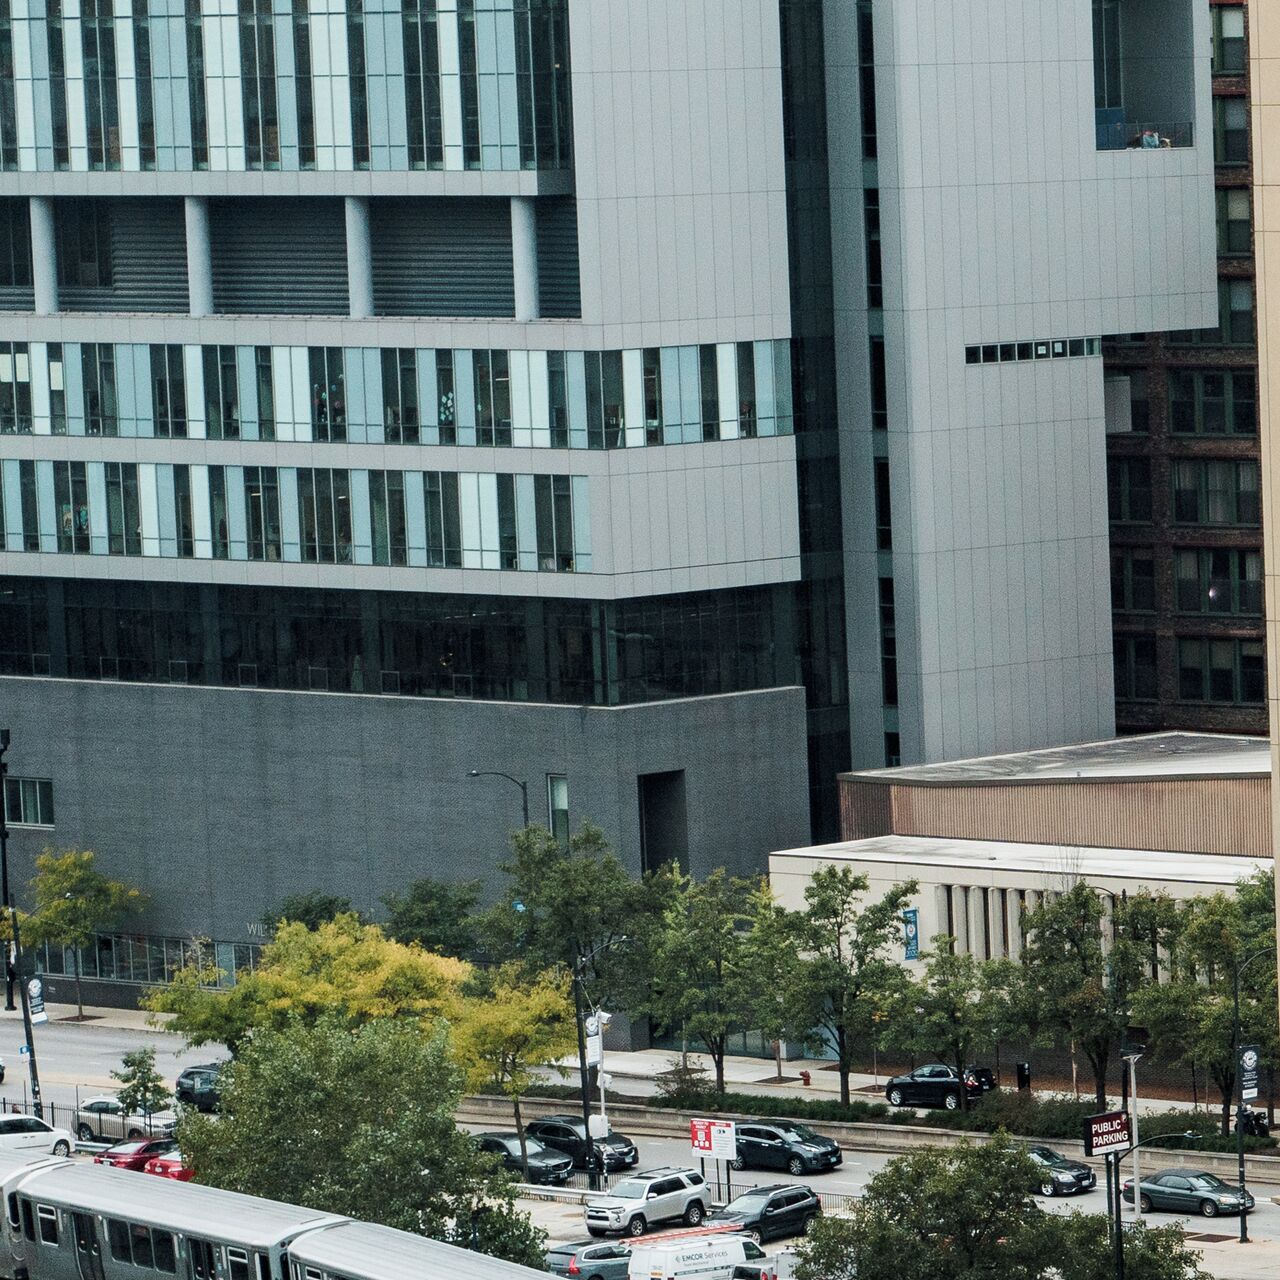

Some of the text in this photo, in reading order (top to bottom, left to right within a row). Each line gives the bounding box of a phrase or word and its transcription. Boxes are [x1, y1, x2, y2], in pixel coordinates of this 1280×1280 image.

[1092, 1120, 1121, 1134] PUBLIC
[1093, 1131, 1128, 1146] PARKING
[682, 1251, 728, 1261] EMCOR Services
